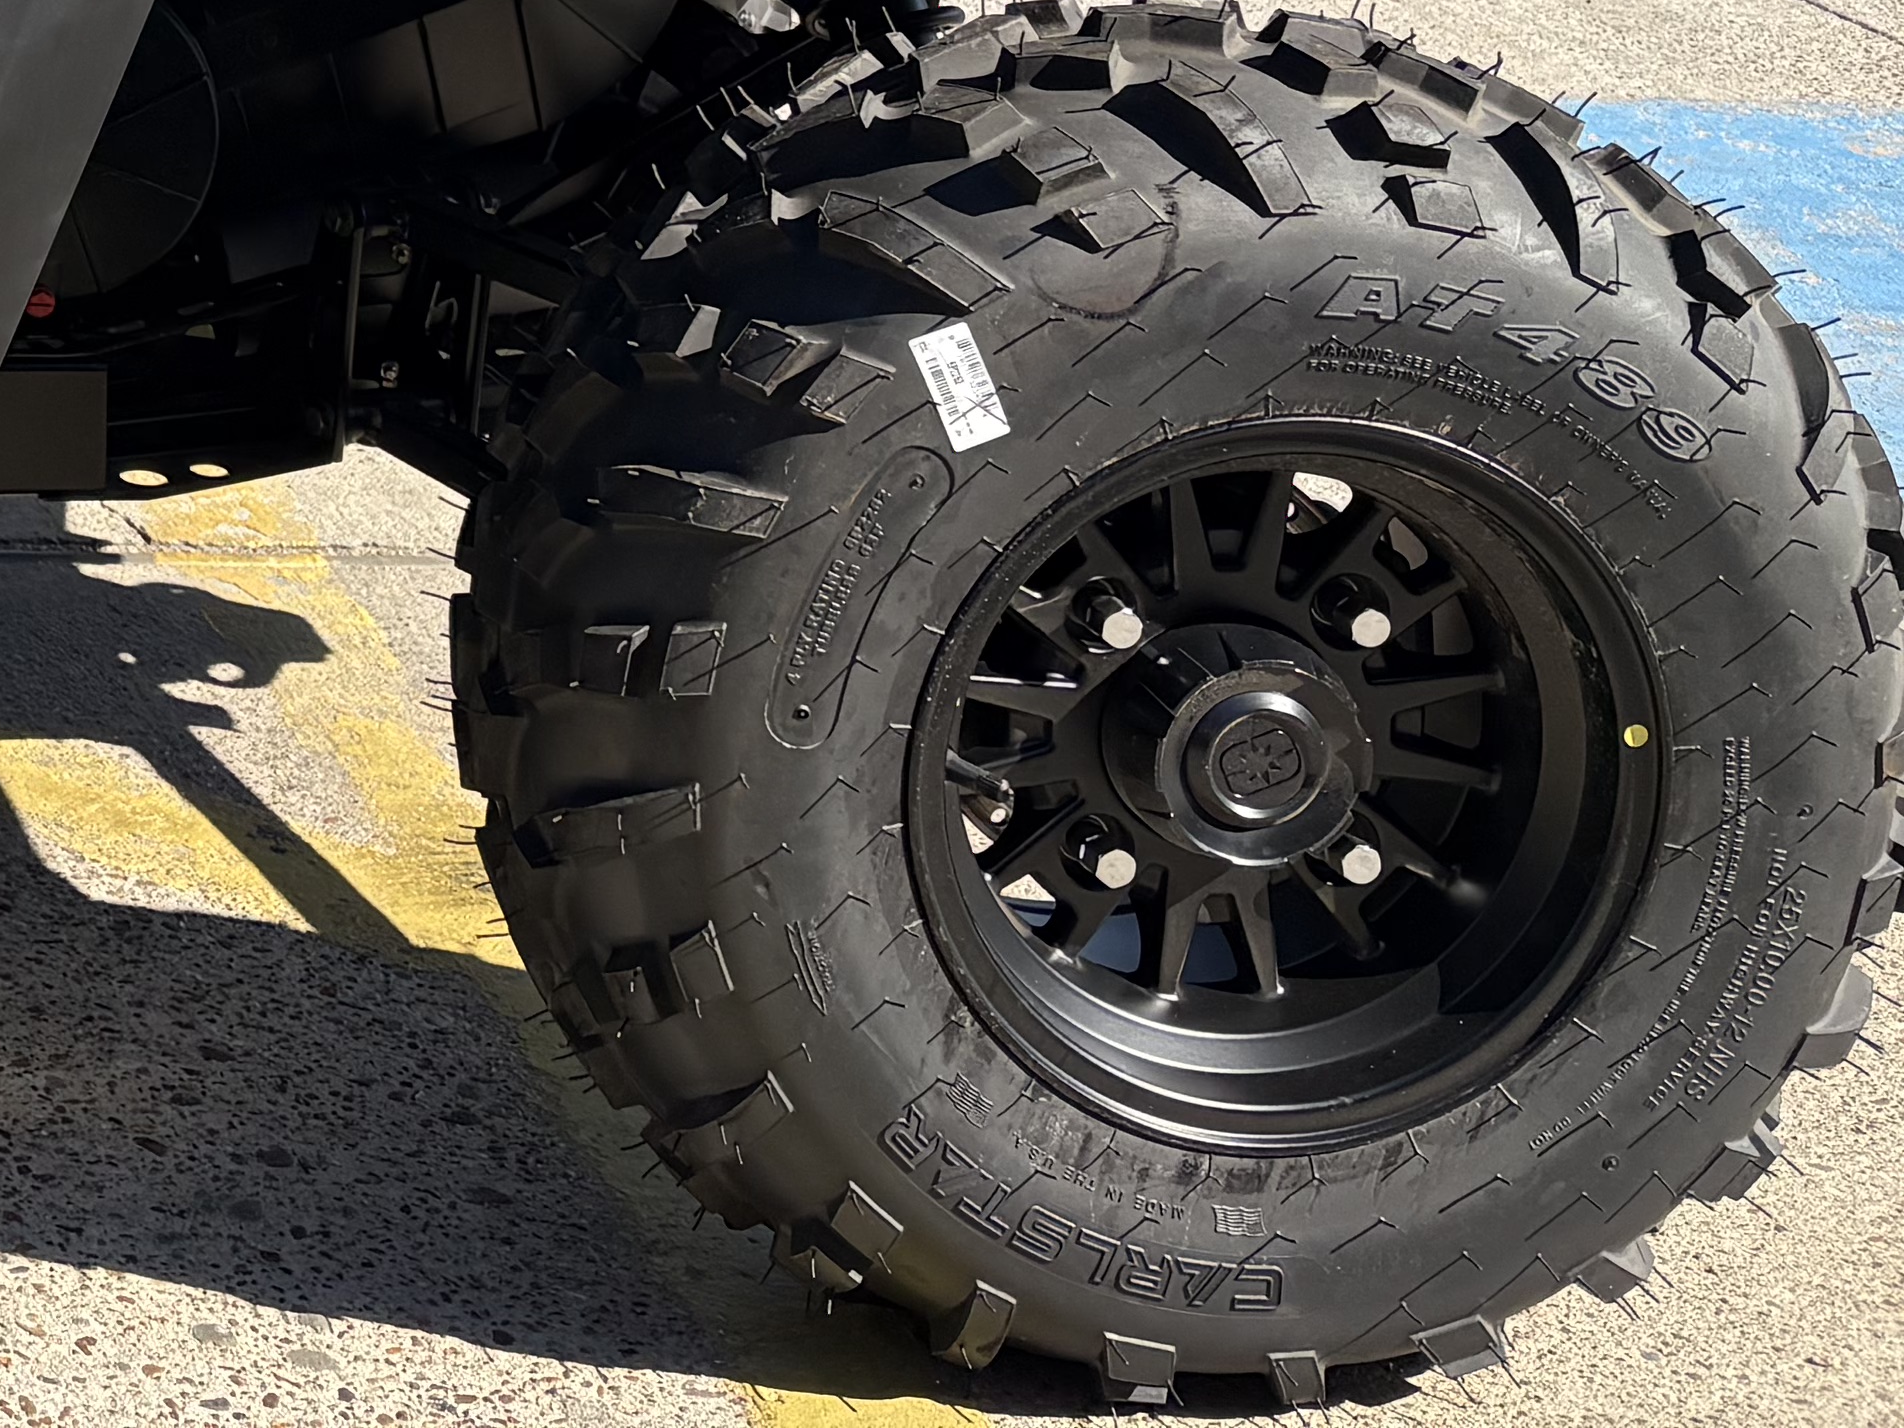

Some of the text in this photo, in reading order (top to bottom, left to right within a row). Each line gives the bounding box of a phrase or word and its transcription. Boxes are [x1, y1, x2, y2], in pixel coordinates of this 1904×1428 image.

[1686, 886, 1807, 1102] 25X10.00-12 NHS
[1058, 1162, 1099, 1195] THE
[1101, 1182, 1127, 1205] IN
[878, 1104, 1285, 1312] CARLSTAR
[1130, 1191, 1186, 1224] MADE
